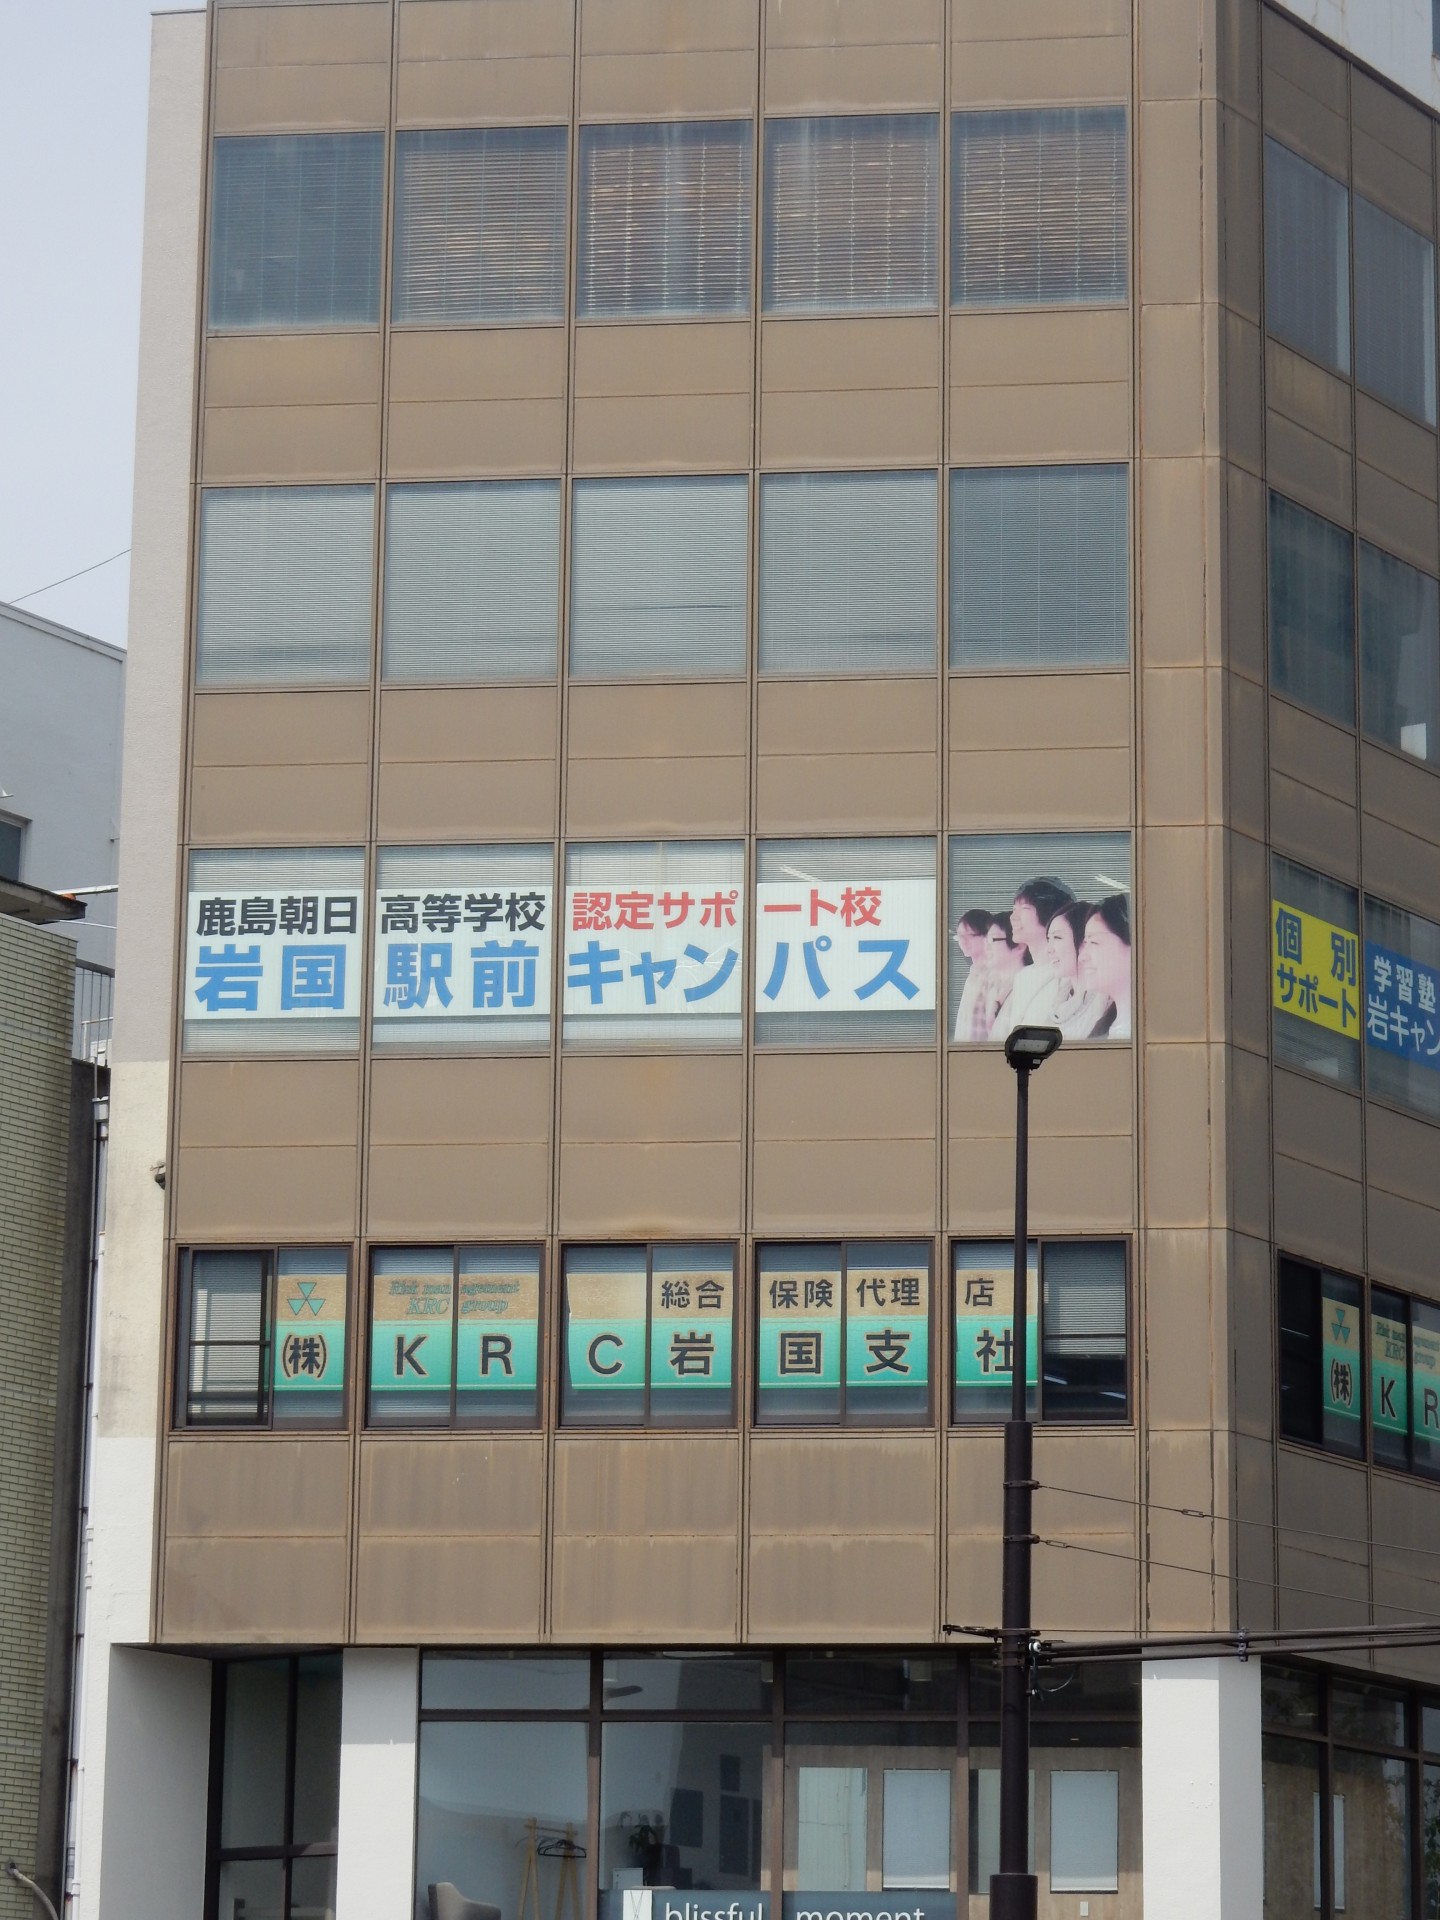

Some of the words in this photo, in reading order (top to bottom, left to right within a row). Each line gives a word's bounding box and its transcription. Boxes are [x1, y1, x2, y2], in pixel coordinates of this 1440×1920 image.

[196, 892, 546, 936] 鹿島朝日高等学校
[572, 887, 882, 931] 認定サポート校
[194, 935, 920, 1012] 岩国駅前キャンパス
[1275, 908, 1357, 987] 個別
[1276, 963, 1357, 1028] サポート
[1373, 954, 1437, 1014] 学習塾
[406, 1298, 449, 1315] KRC
[661, 1278, 994, 1309] 総合保険代理店
[665, 1903, 763, 1920] blissful
[796, 1908, 925, 1920] moment
